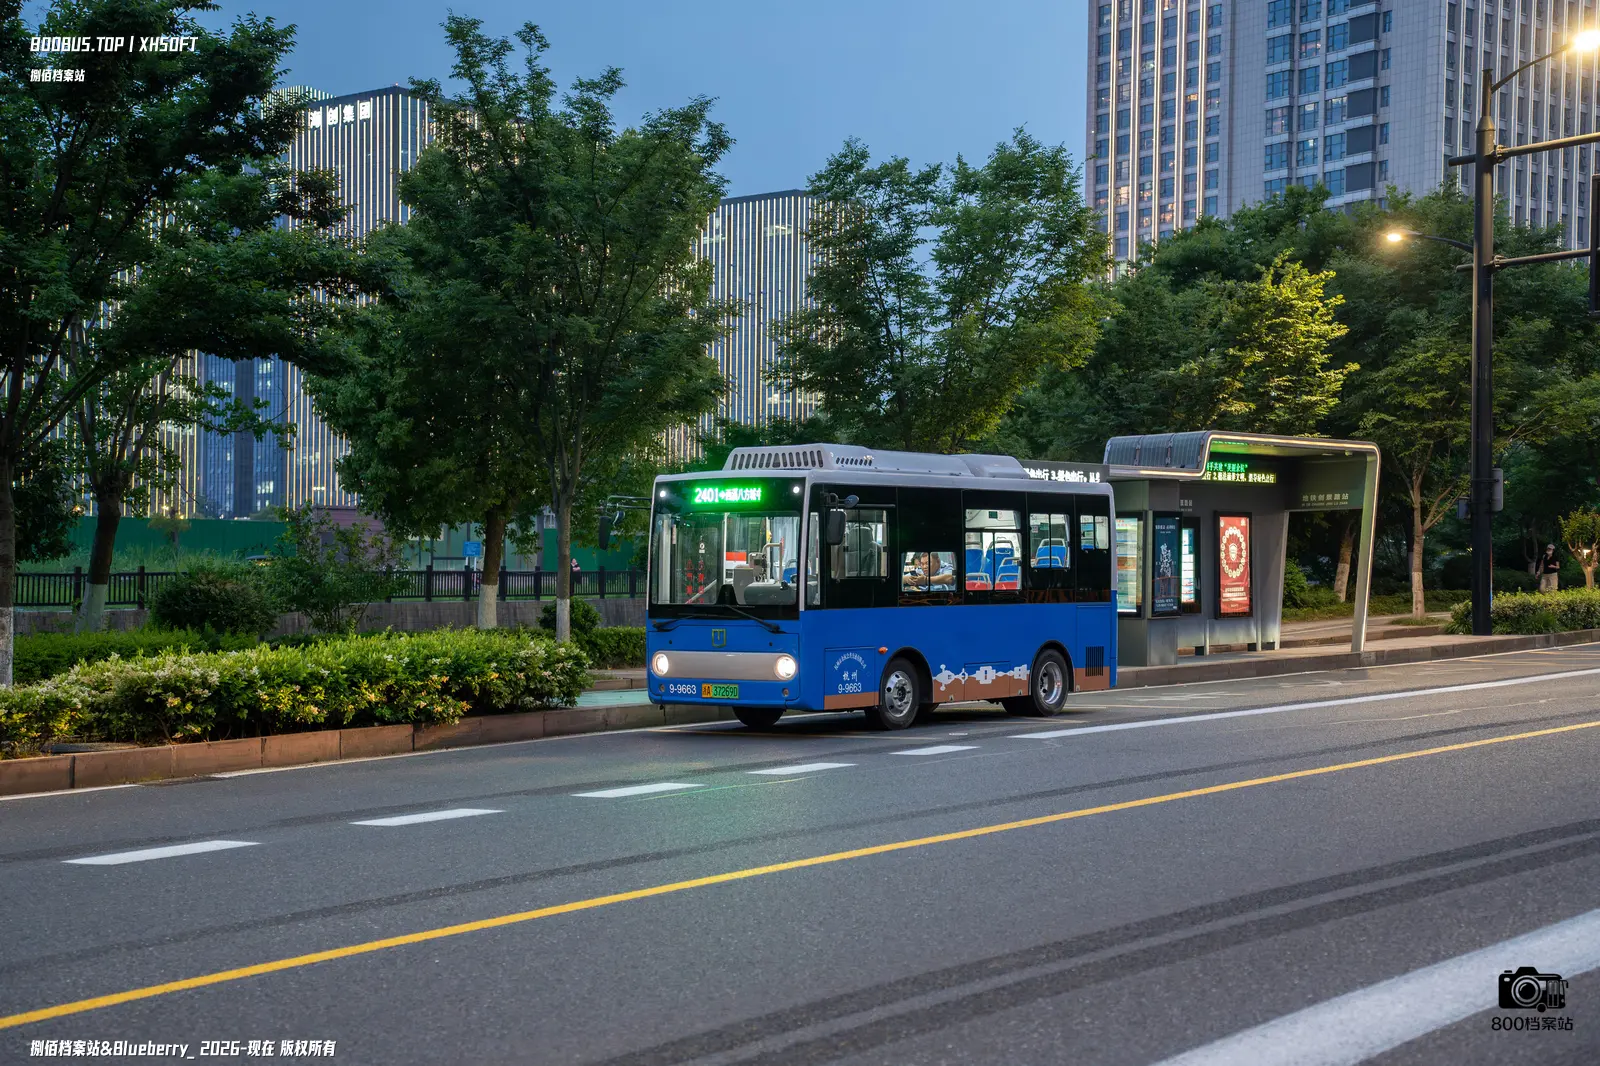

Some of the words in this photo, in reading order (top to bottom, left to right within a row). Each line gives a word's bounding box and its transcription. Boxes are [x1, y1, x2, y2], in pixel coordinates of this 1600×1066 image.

[694, 487, 719, 503] 2401
[669, 683, 697, 695] 9-9663
[838, 682, 862, 694] 9-9663
